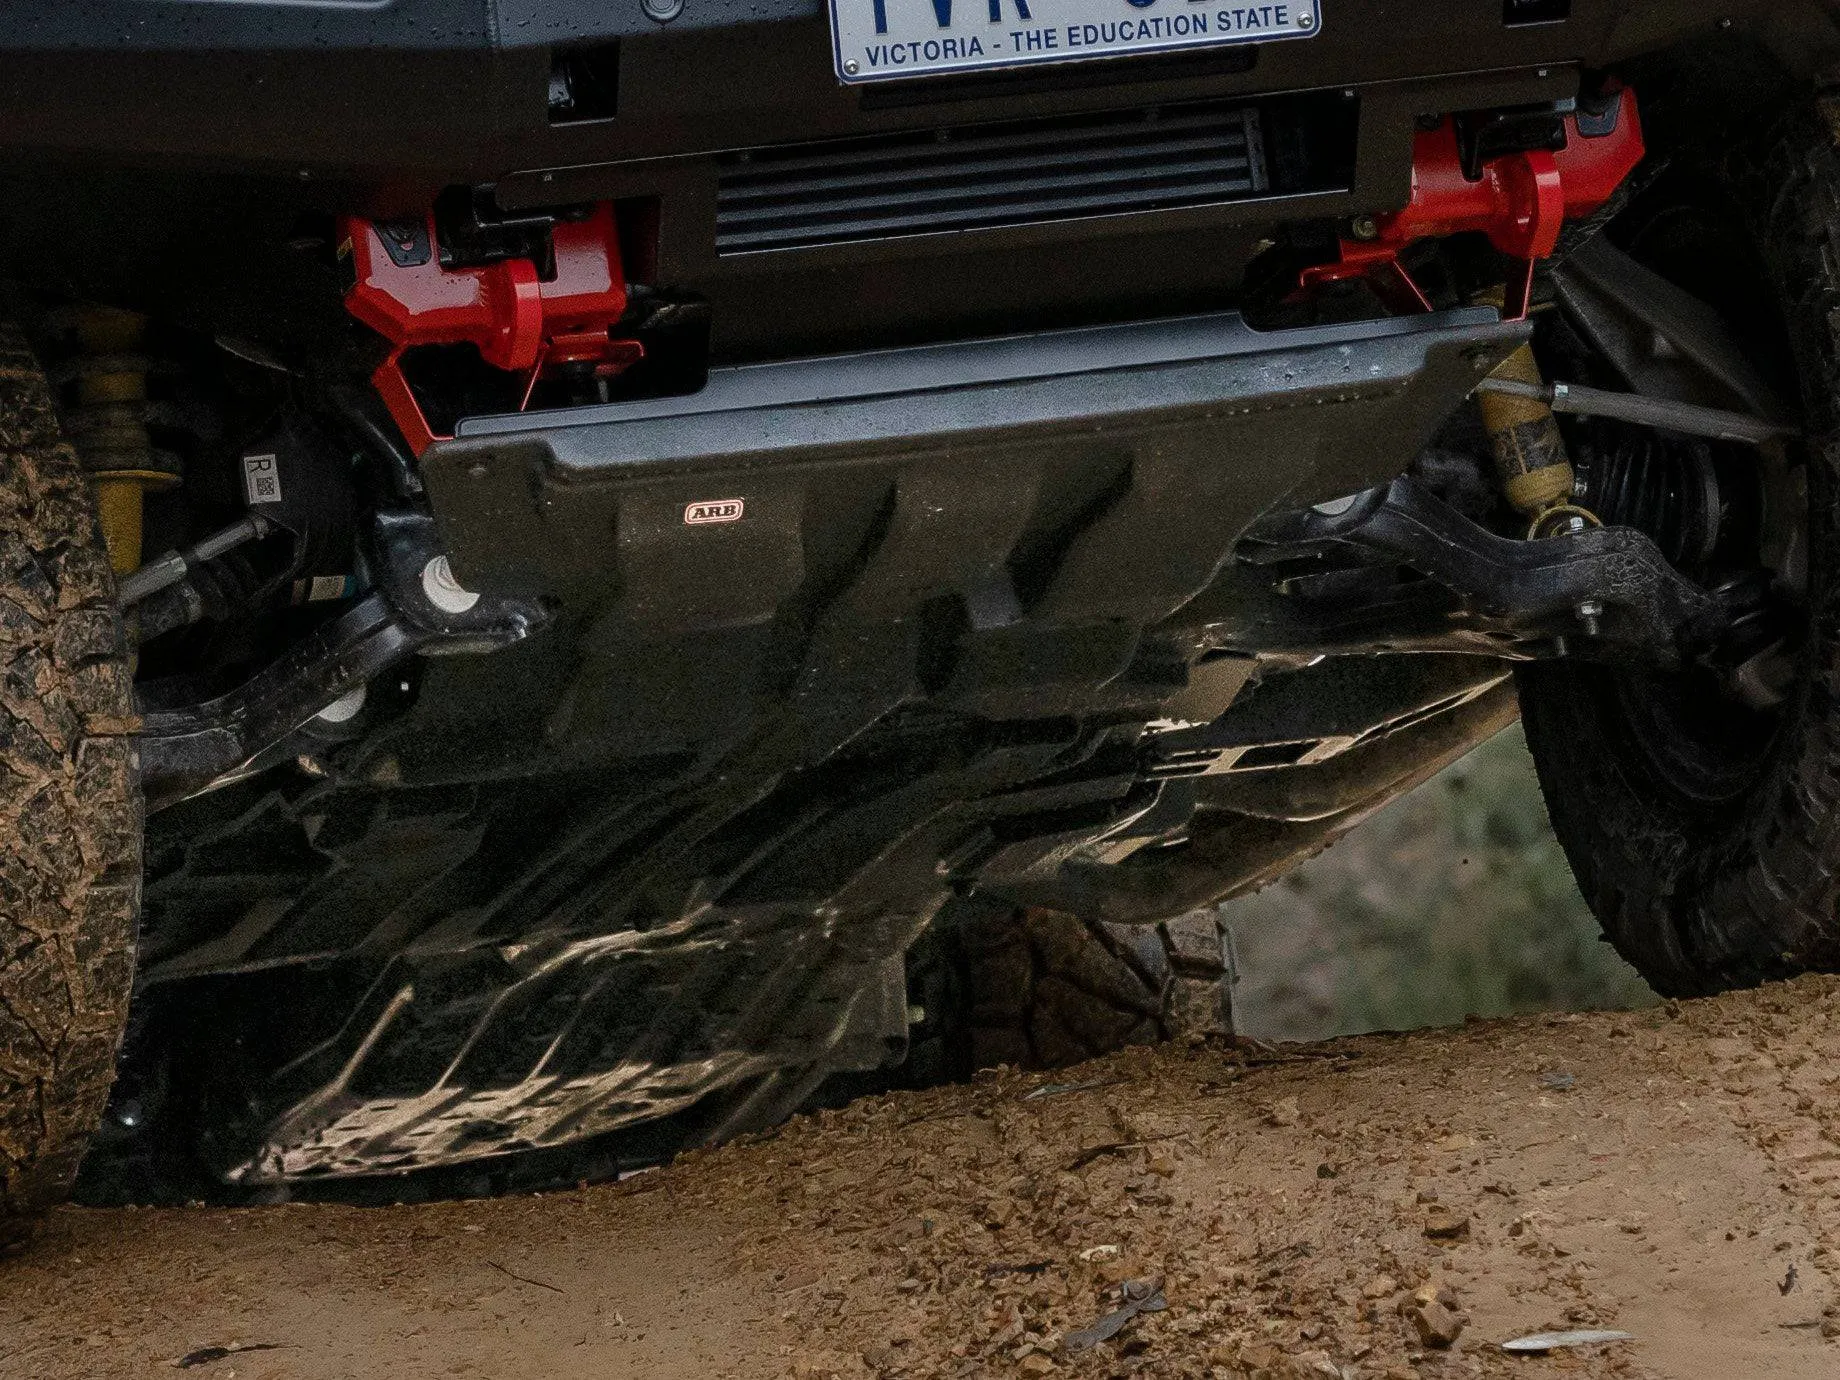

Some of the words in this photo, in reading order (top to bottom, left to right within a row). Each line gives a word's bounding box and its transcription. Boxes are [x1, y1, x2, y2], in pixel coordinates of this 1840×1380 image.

[865, 36, 984, 67] VICTORIA
[1010, 28, 1058, 52] THE
[1067, 12, 1209, 47] EDUCATION
[1216, 5, 1289, 32] STATE
[246, 459, 272, 473] R
[691, 504, 737, 520] ARB
